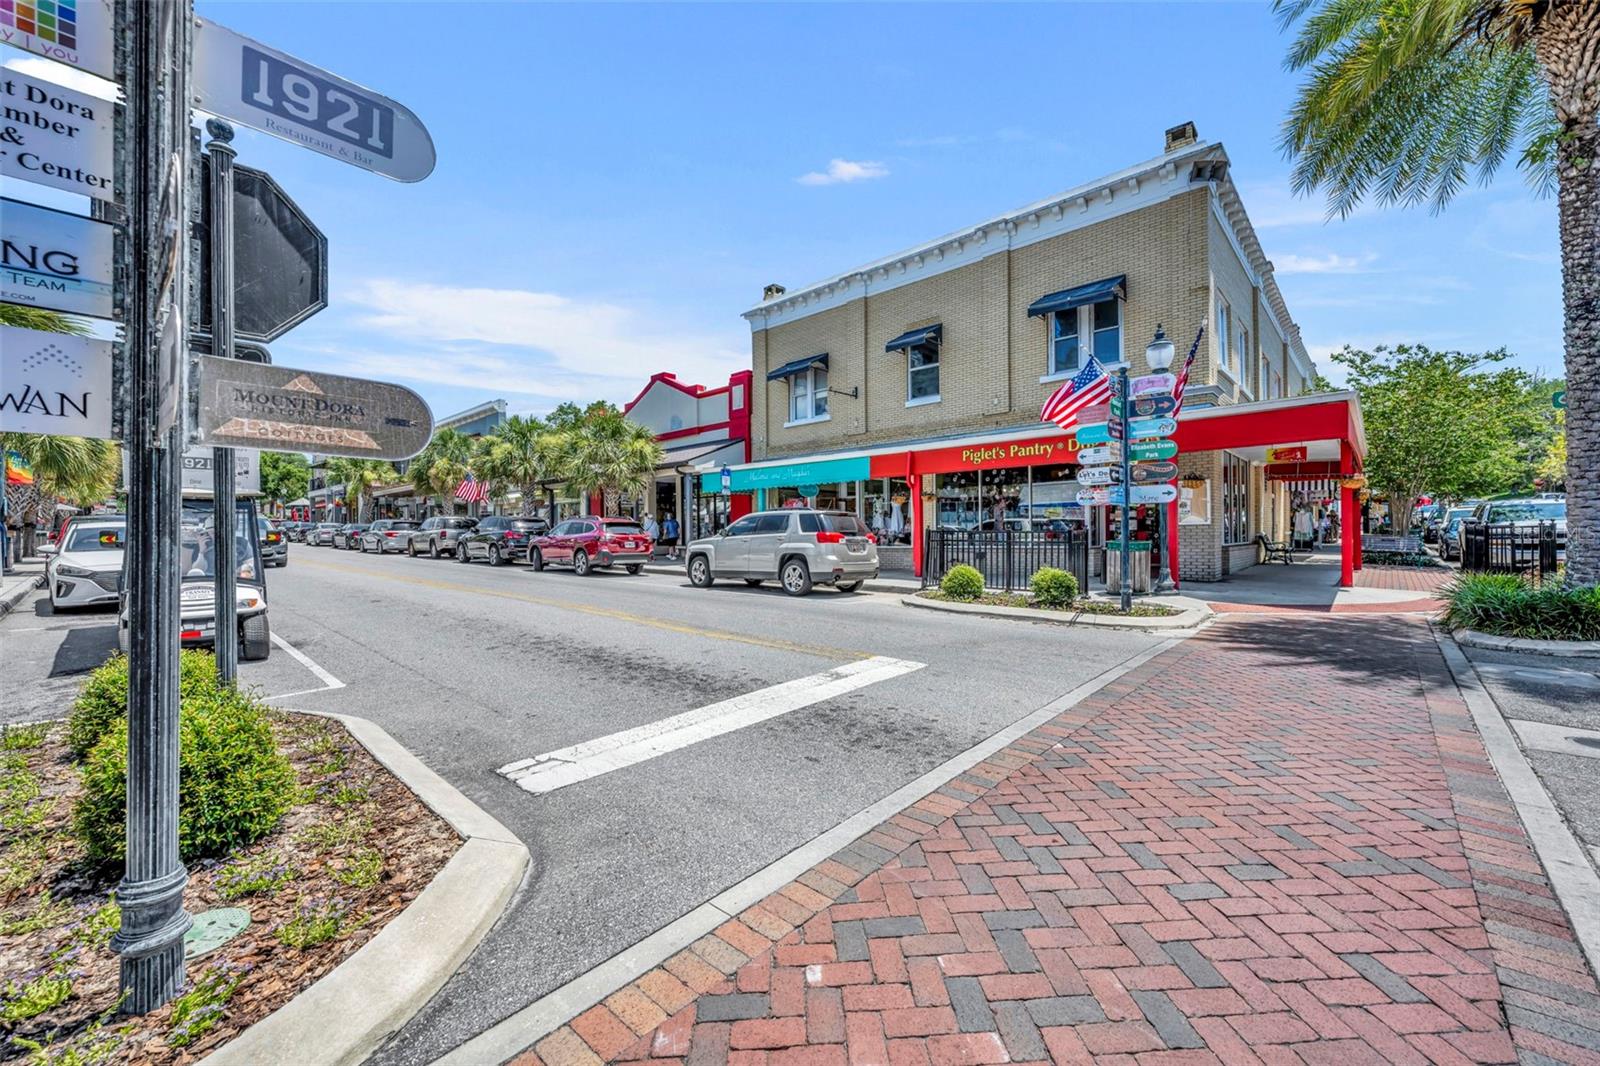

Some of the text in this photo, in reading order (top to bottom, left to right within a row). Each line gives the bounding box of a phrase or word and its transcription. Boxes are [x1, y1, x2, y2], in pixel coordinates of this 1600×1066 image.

[40, 42, 79, 64] you
[24, 83, 95, 121] Dora
[252, 59, 385, 150] 1921
[0, 126, 25, 146] &
[265, 117, 375, 167] Restaurant & Bar
[16, 152, 112, 189] Center
[315, 398, 366, 417] DORA
[258, 426, 344, 444] COTTAGES
[962, 445, 1006, 464] Piglet's
[1010, 443, 1054, 458] Pantry
[1131, 442, 1156, 451] Elizabeth
